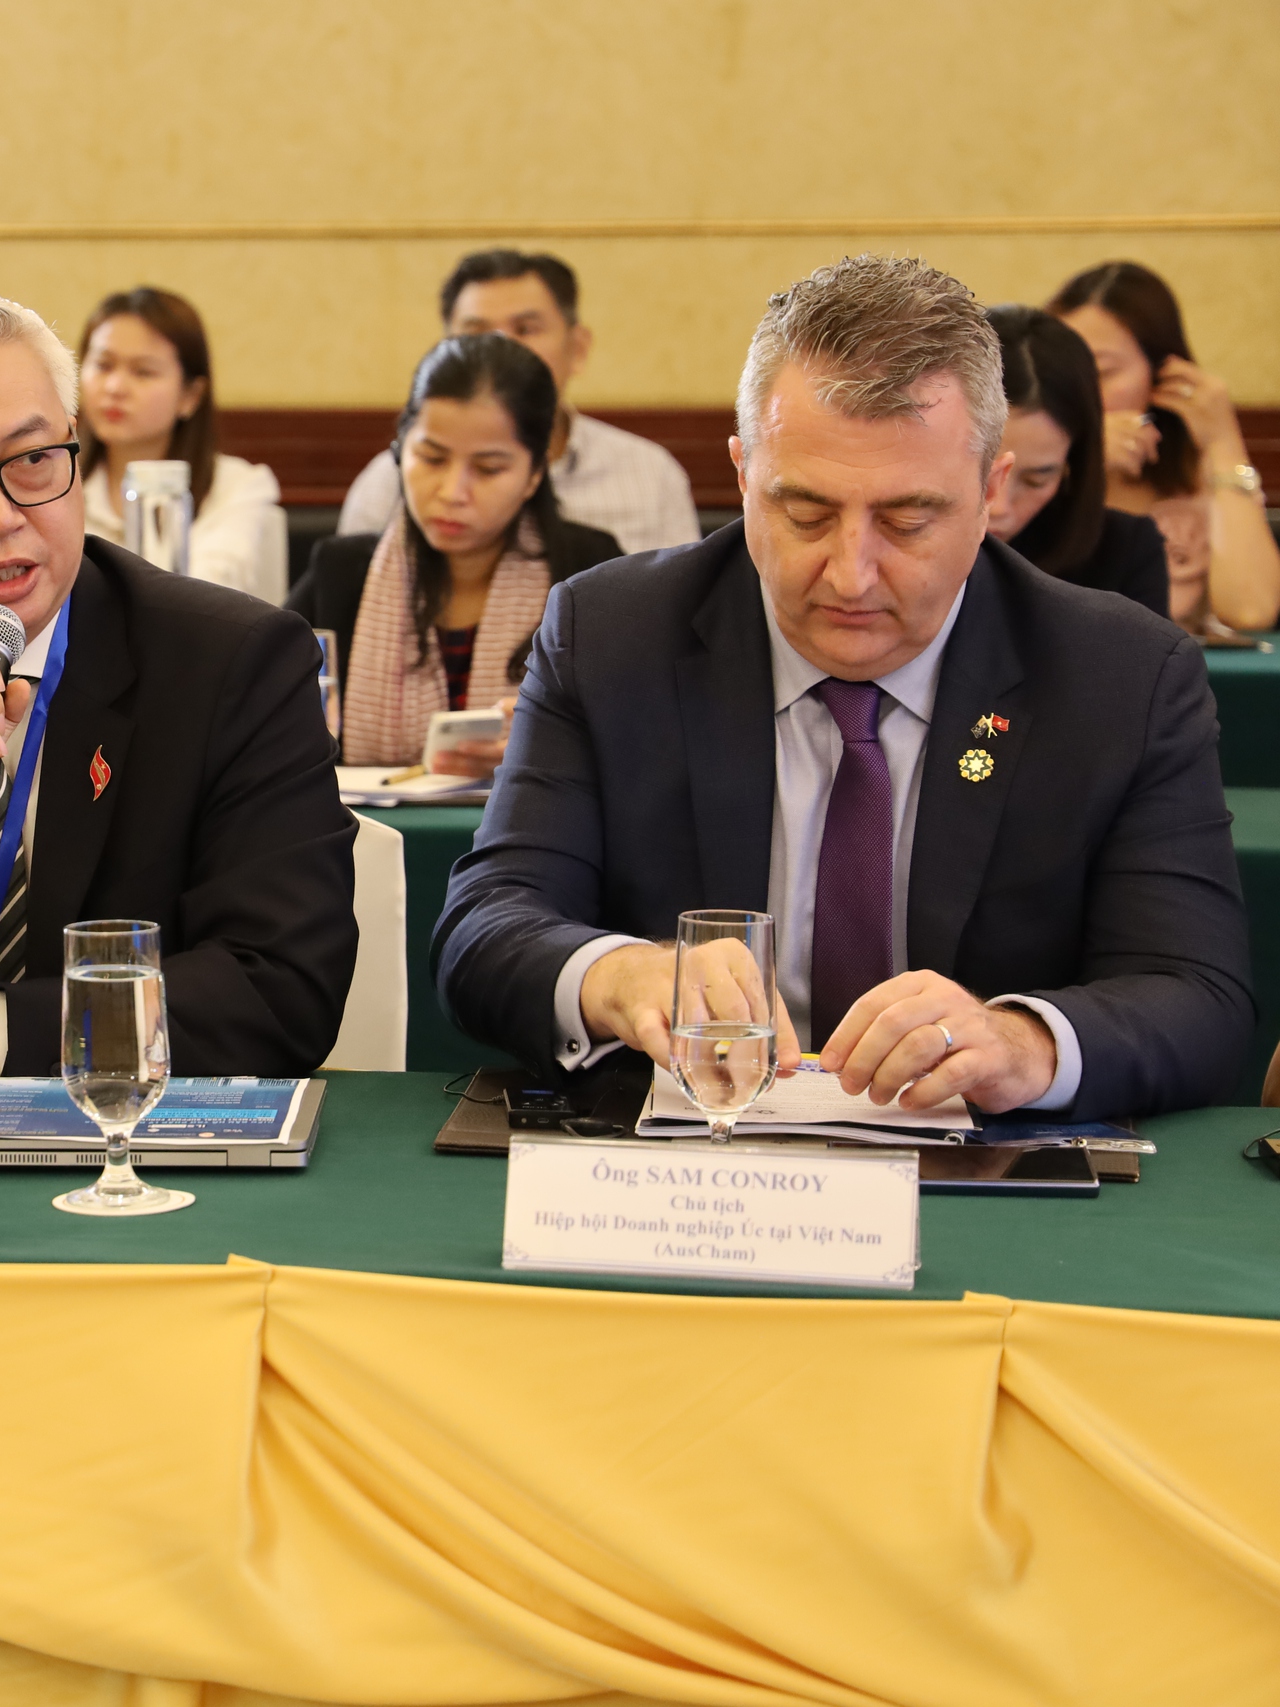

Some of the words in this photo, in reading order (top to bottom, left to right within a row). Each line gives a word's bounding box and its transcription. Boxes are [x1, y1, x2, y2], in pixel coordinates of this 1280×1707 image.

[592, 1157, 639, 1187] Ông
[646, 1165, 703, 1186] SAM
[711, 1168, 828, 1193] CONROY
[670, 1194, 706, 1211] Chủ
[713, 1197, 745, 1216] tịch
[535, 1211, 575, 1231] Hiệp
[581, 1213, 607, 1232] hội
[614, 1215, 669, 1232] Doanh
[676, 1218, 734, 1240] nghiệp
[742, 1217, 764, 1238] Úc
[770, 1224, 792, 1243] tại
[799, 1225, 833, 1246] Việt
[840, 1227, 882, 1245] Nam
[655, 1242, 756, 1264] (AusCham)
